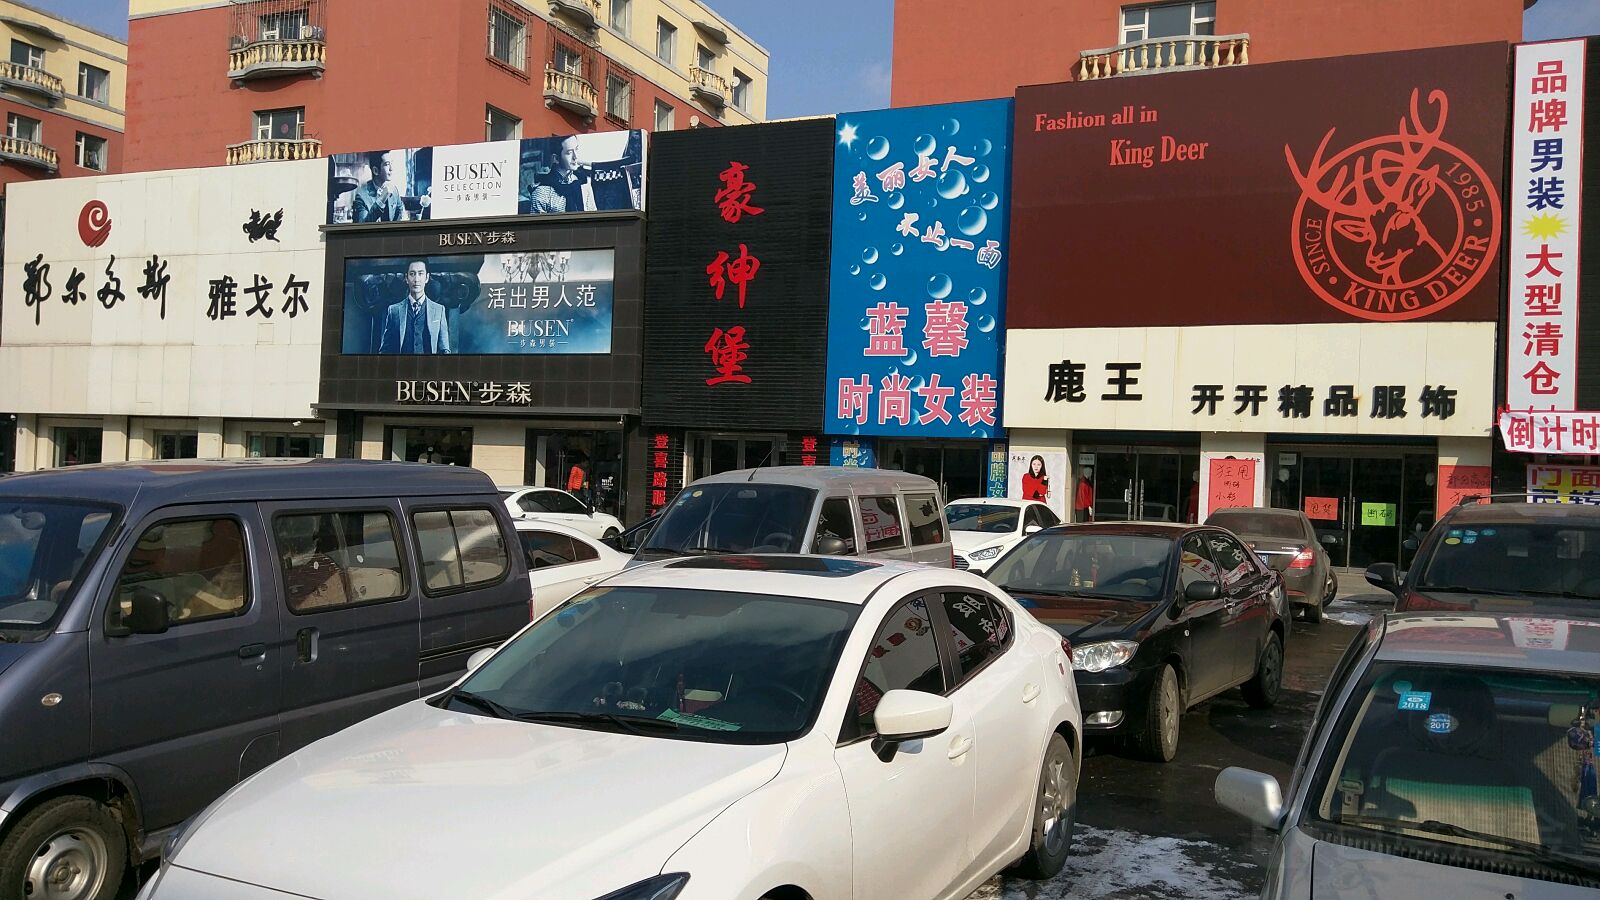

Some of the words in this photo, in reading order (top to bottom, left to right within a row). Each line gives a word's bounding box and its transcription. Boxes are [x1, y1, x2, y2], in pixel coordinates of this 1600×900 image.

[1034, 112, 1106, 132] Fashion
[1111, 106, 1134, 125] all
[1139, 106, 1158, 122] in
[1526, 60, 1568, 211] 品牌男装
[849, 145, 976, 206] 美丽女人
[1109, 139, 1155, 168] King
[1160, 135, 1209, 163] Deer
[443, 181, 502, 192] SELECTION
[1444, 162, 1485, 214] 1985
[486, 231, 517, 245] 步森
[896, 212, 1002, 269] 不止一面
[1304, 218, 1330, 276] SINCE
[23, 253, 171, 325] 鄂尔多斯
[206, 273, 310, 320] 雅戈尔
[487, 284, 597, 310] 活出男人范
[704, 161, 766, 387] 豪绅堡
[1343, 281, 1420, 312] KING
[1424, 235, 1490, 302] DEER
[863, 300, 969, 357] 蓝馨
[1522, 243, 1563, 412] 大型清仓
[478, 381, 533, 405] 步森
[837, 373, 998, 427] 时尚女装
[1044, 359, 1144, 403] 鹿王
[1190, 384, 1459, 421] 开开精品服饰
[1507, 416, 1600, 450] 倒计时
[651, 433, 669, 516] 登喜路服
